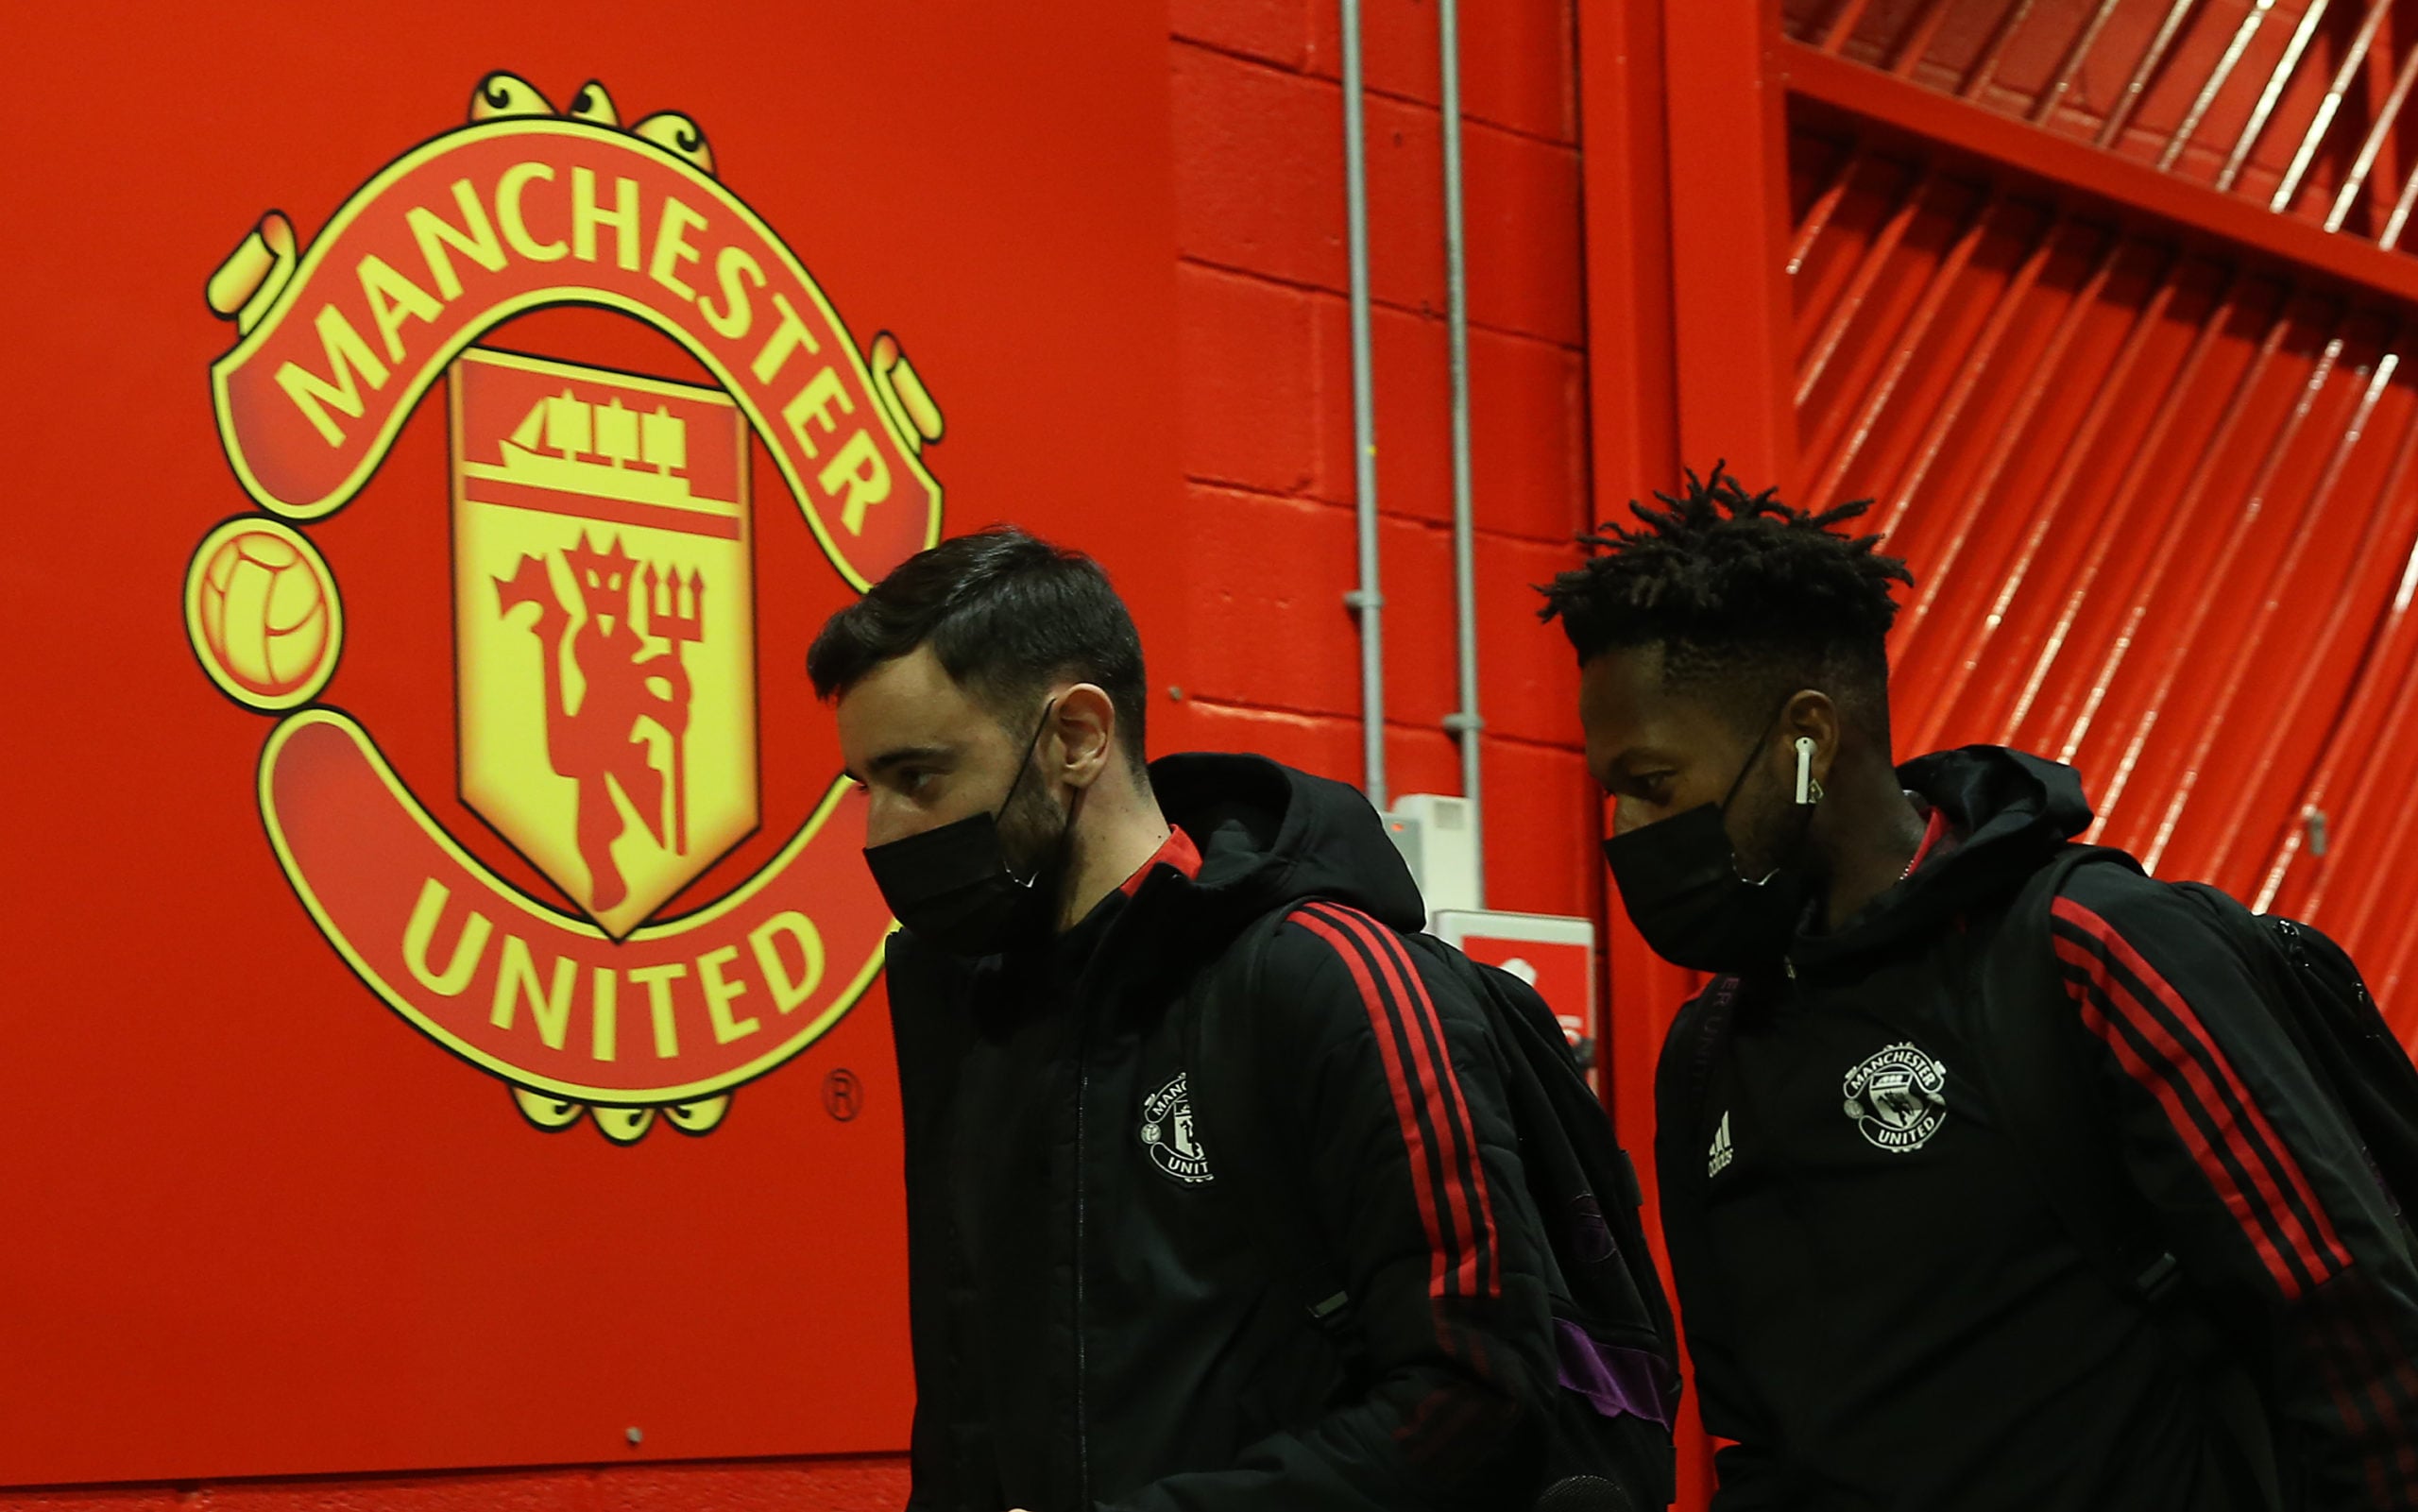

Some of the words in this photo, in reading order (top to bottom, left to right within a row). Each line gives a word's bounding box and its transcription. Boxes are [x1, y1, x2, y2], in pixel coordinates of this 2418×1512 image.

[274, 161, 893, 536] MANCHESTER
[402, 876, 826, 1062] UNITED
[1851, 1051, 1936, 1090] MANCHESTER
[1151, 1080, 1187, 1116] MANC
[1878, 1116, 1935, 1145] UNITED
[1167, 1157, 1208, 1174] UNIT
